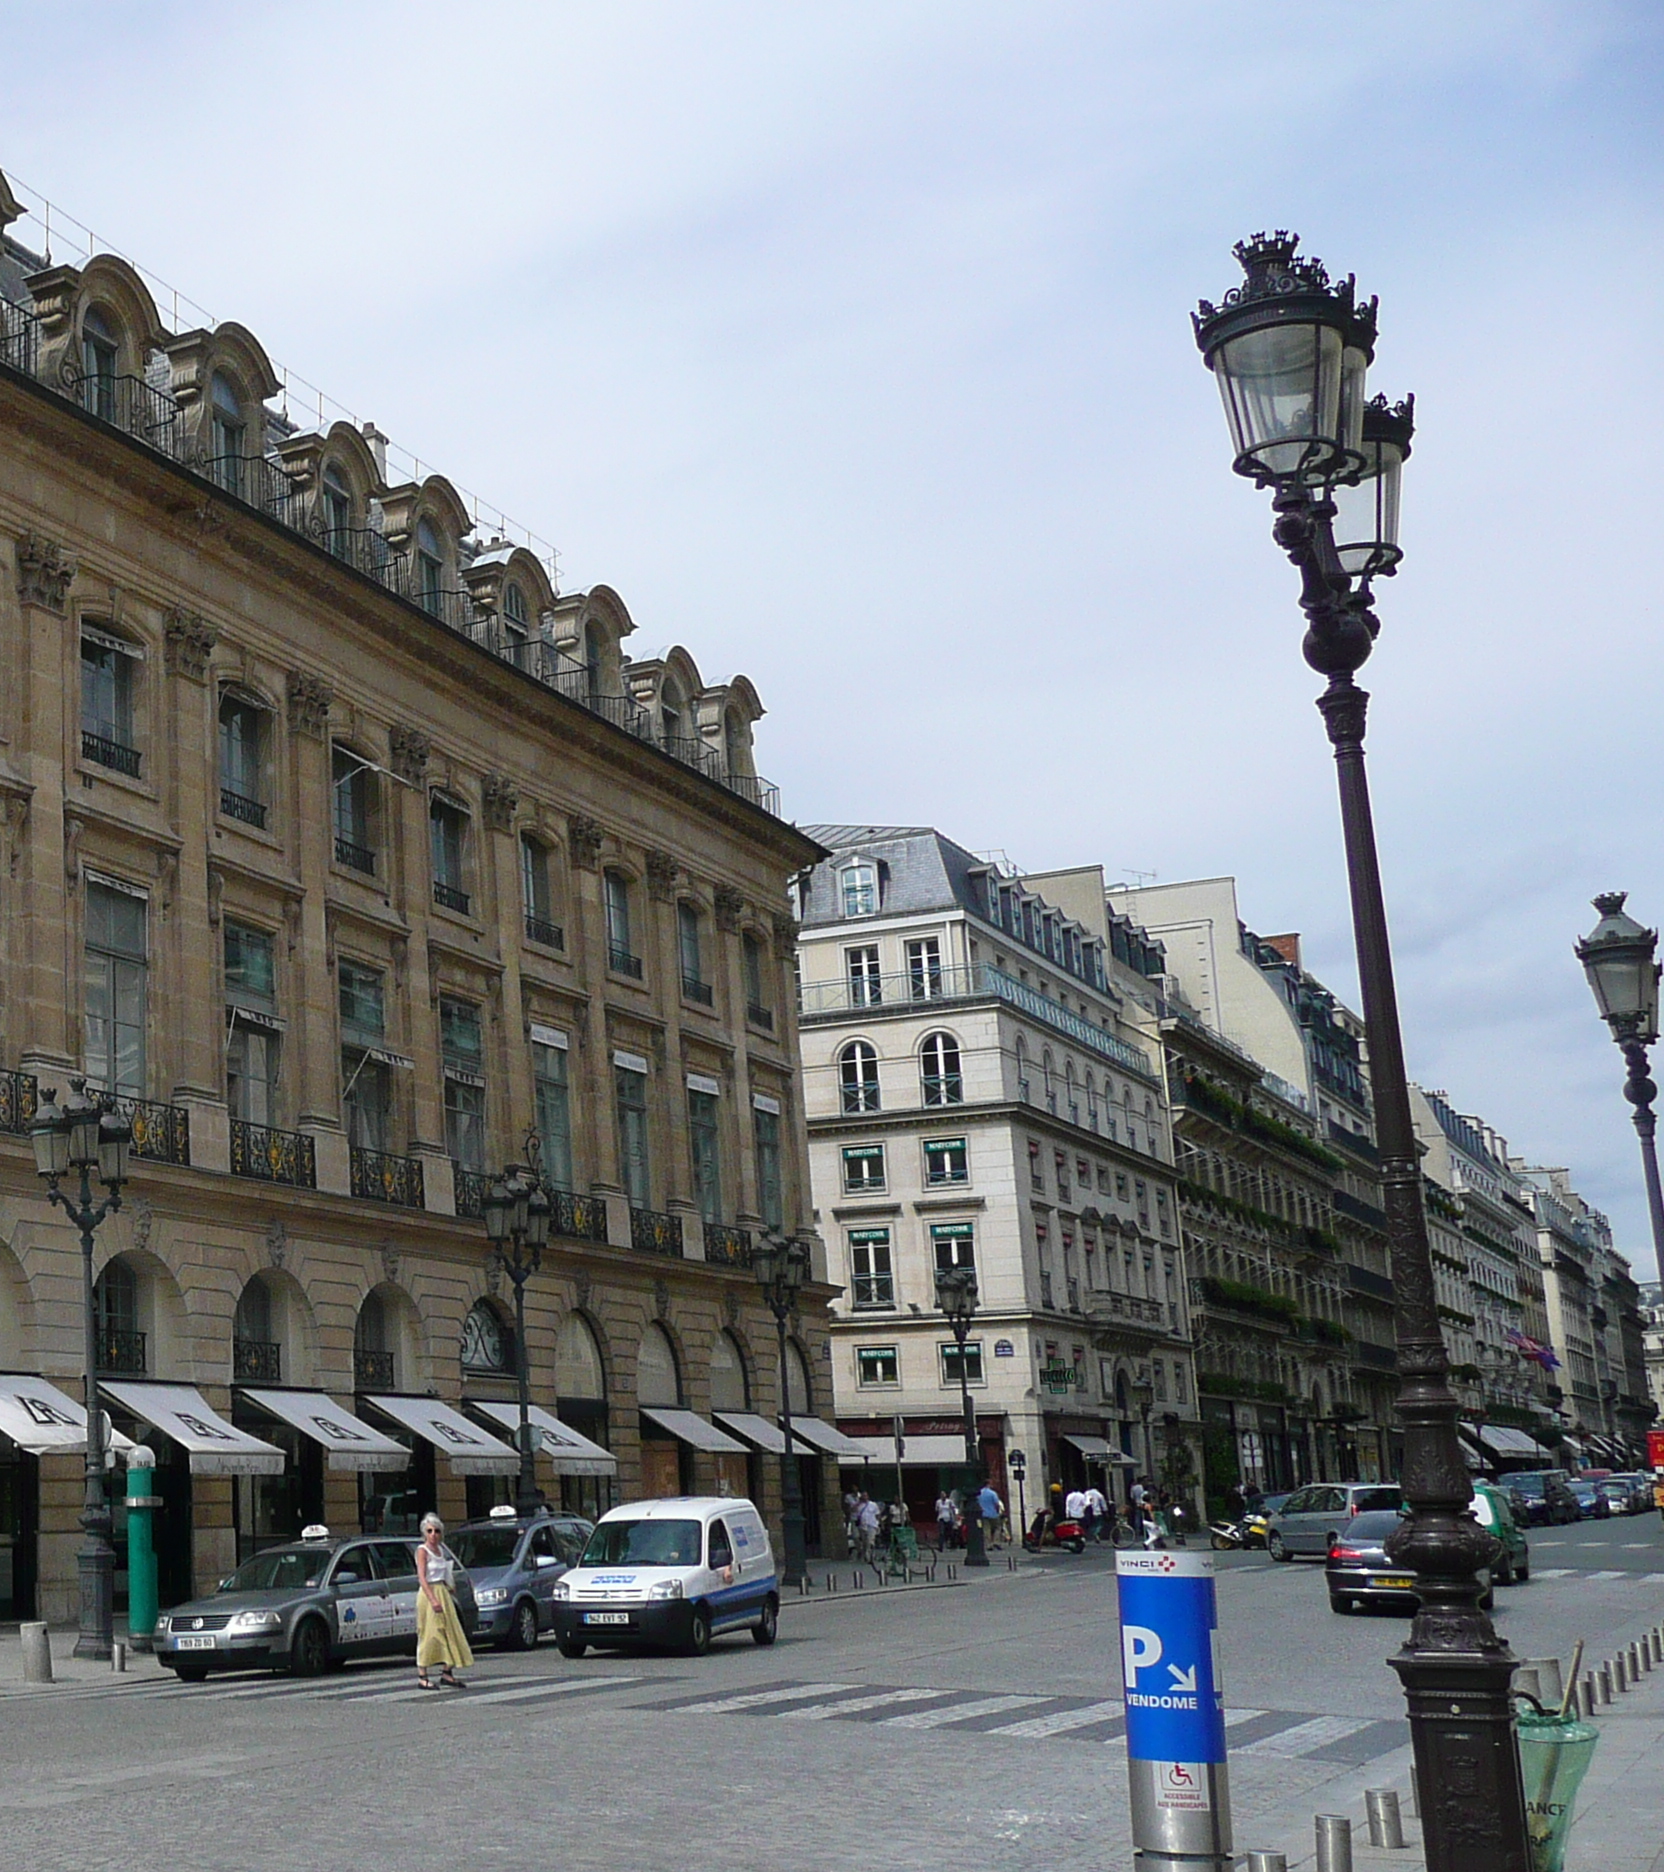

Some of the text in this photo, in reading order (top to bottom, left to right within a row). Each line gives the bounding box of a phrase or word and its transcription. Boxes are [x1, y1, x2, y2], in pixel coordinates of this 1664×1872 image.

[1120, 1560, 1155, 1568] VINCI
[1122, 1624, 1163, 1689] P
[1126, 1692, 1198, 1710] VENDOME
[1526, 1802, 1566, 1816] ANCE
